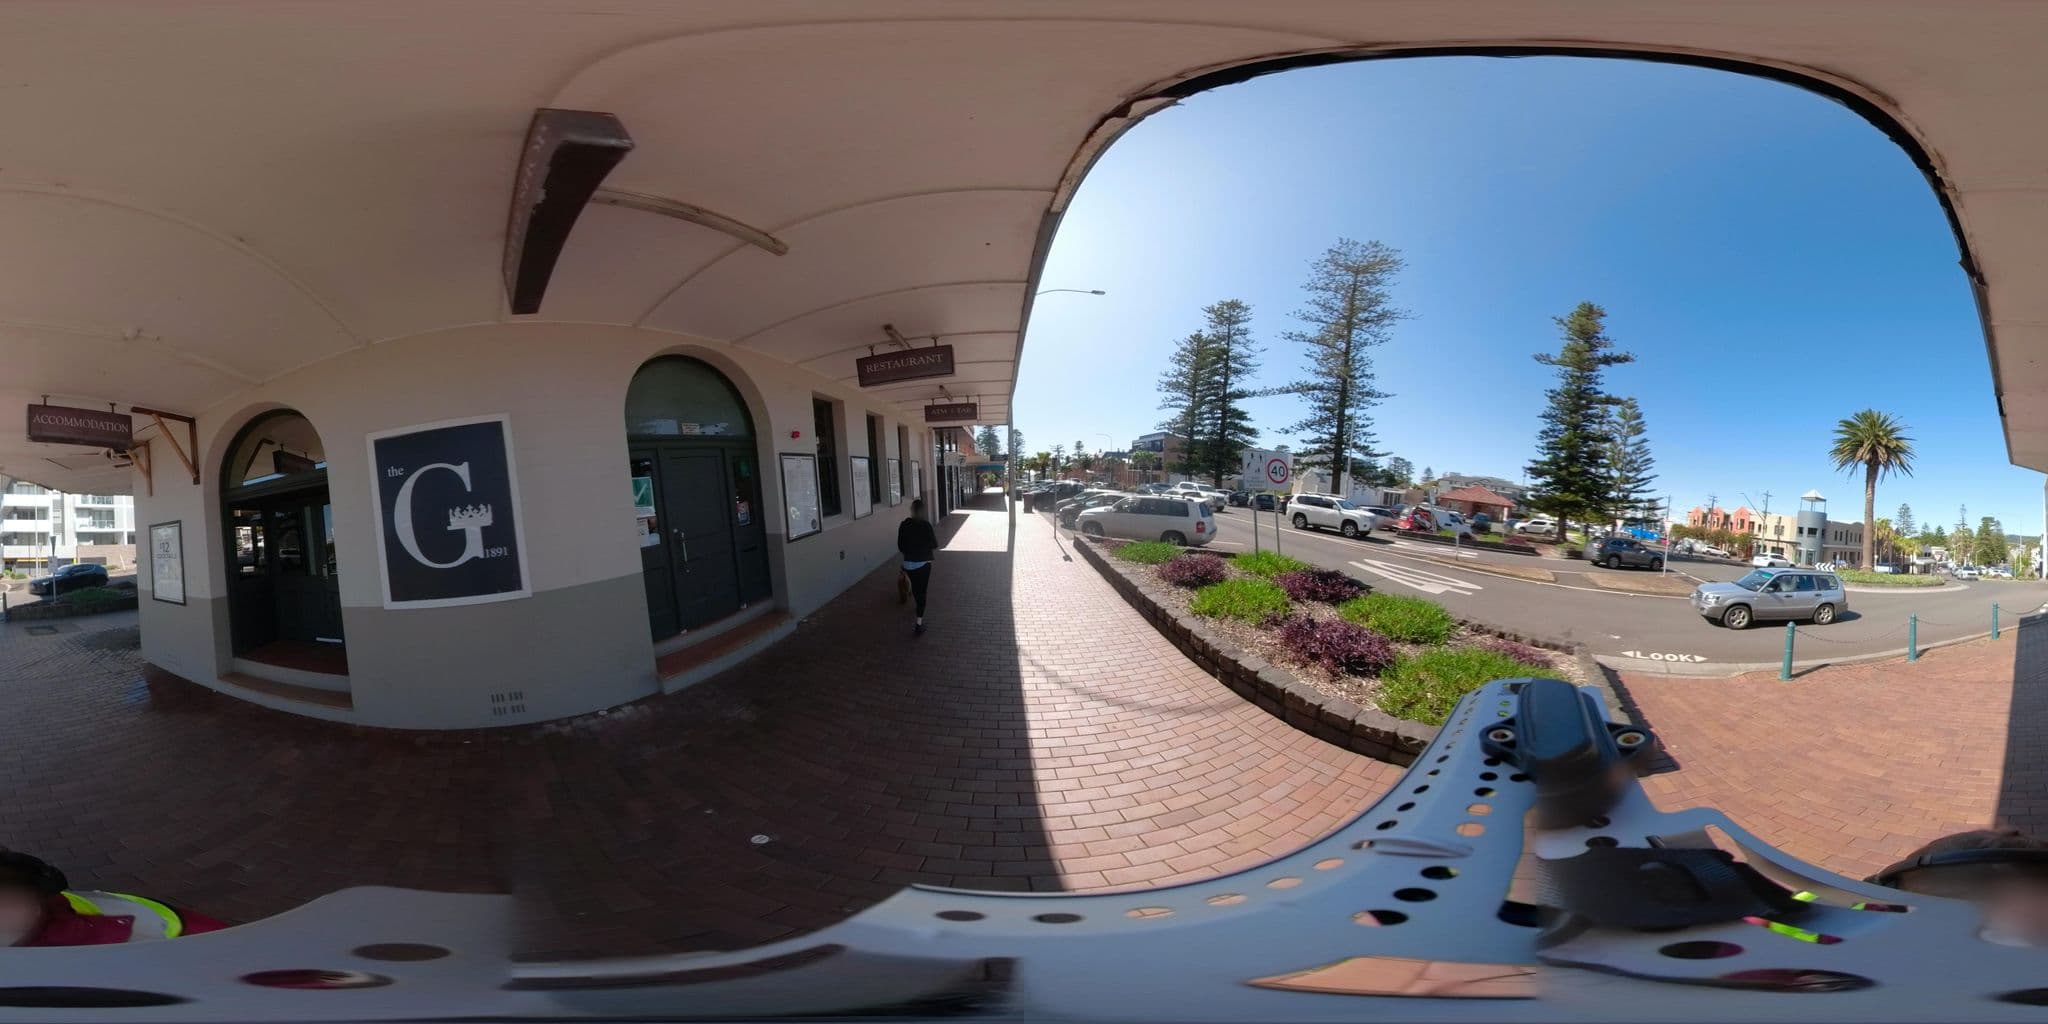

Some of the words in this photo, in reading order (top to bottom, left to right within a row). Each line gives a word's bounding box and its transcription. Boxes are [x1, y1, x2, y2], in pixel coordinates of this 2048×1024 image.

[865, 353, 944, 373] RESTAURANT
[33, 414, 129, 433] ACCOMMODATION
[387, 466, 404, 477] the
[1271, 465, 1285, 477] 40
[394, 461, 493, 568] G
[485, 547, 508, 558] 1891
[1636, 650, 1694, 662] LOOK
